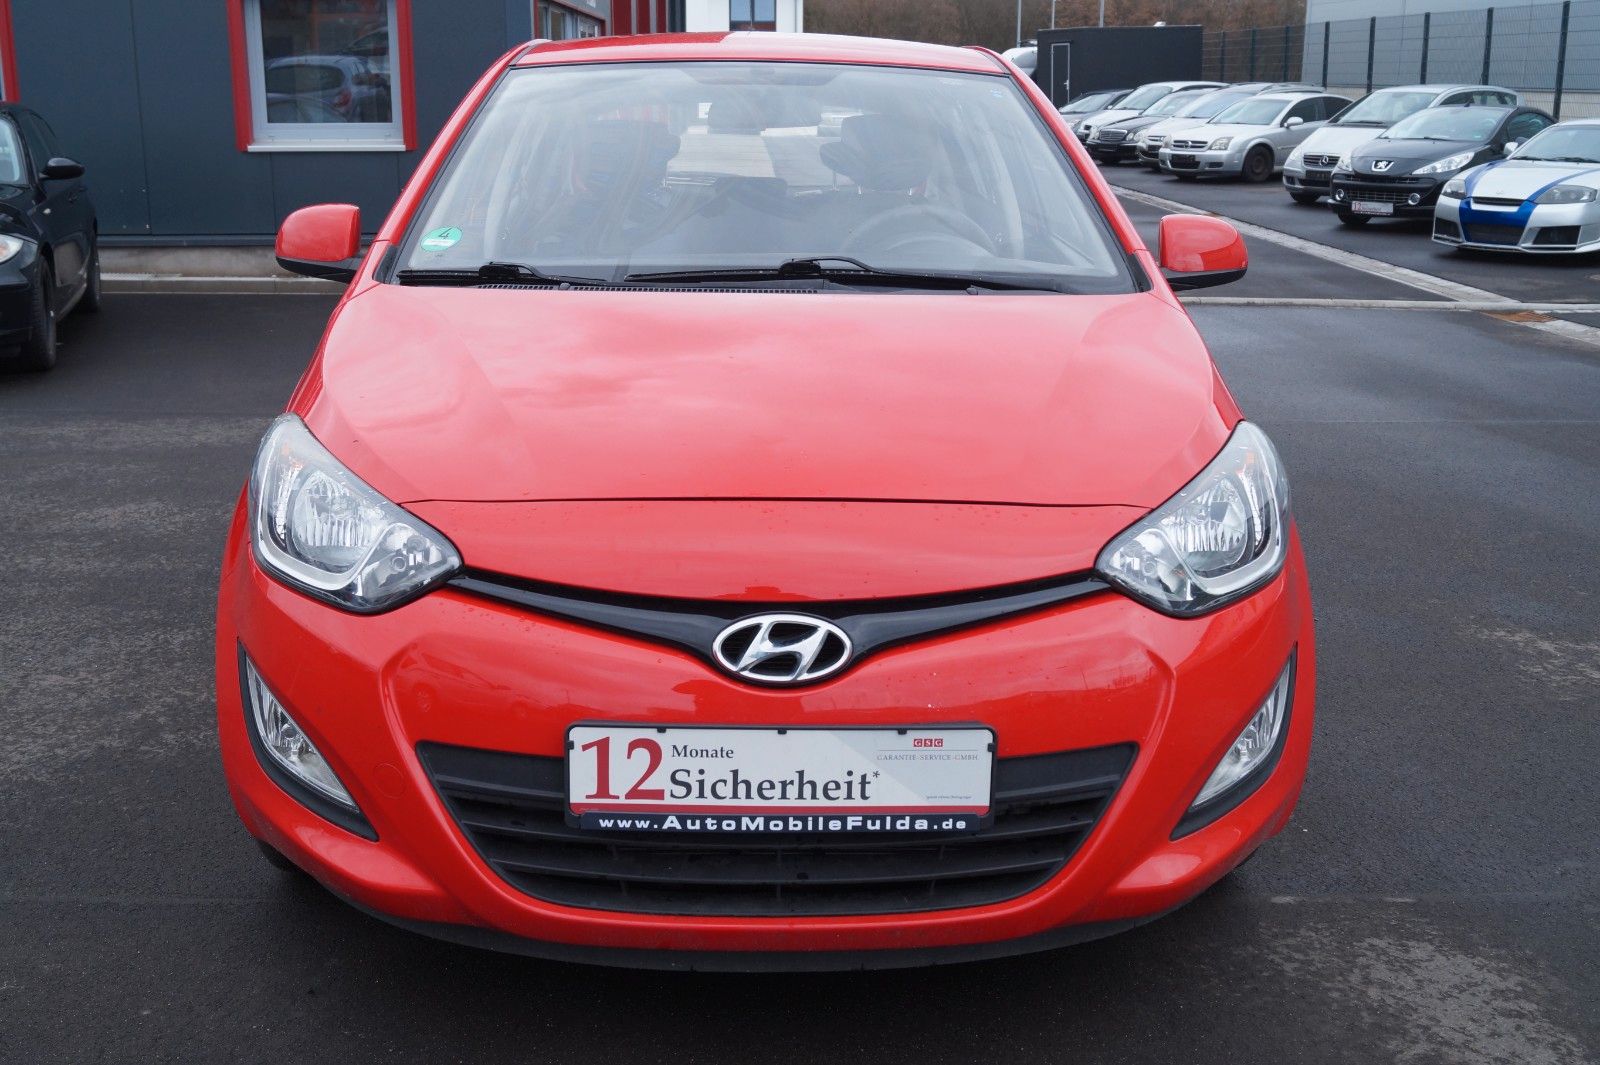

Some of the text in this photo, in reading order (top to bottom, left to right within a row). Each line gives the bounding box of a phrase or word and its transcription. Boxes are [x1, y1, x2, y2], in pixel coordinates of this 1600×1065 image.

[438, 228, 452, 239] 4
[913, 739, 944, 748] GSG
[671, 745, 734, 759] Monate
[581, 736, 665, 800] 12
[599, 815, 967, 831] www.AutoMobileFulda.de
